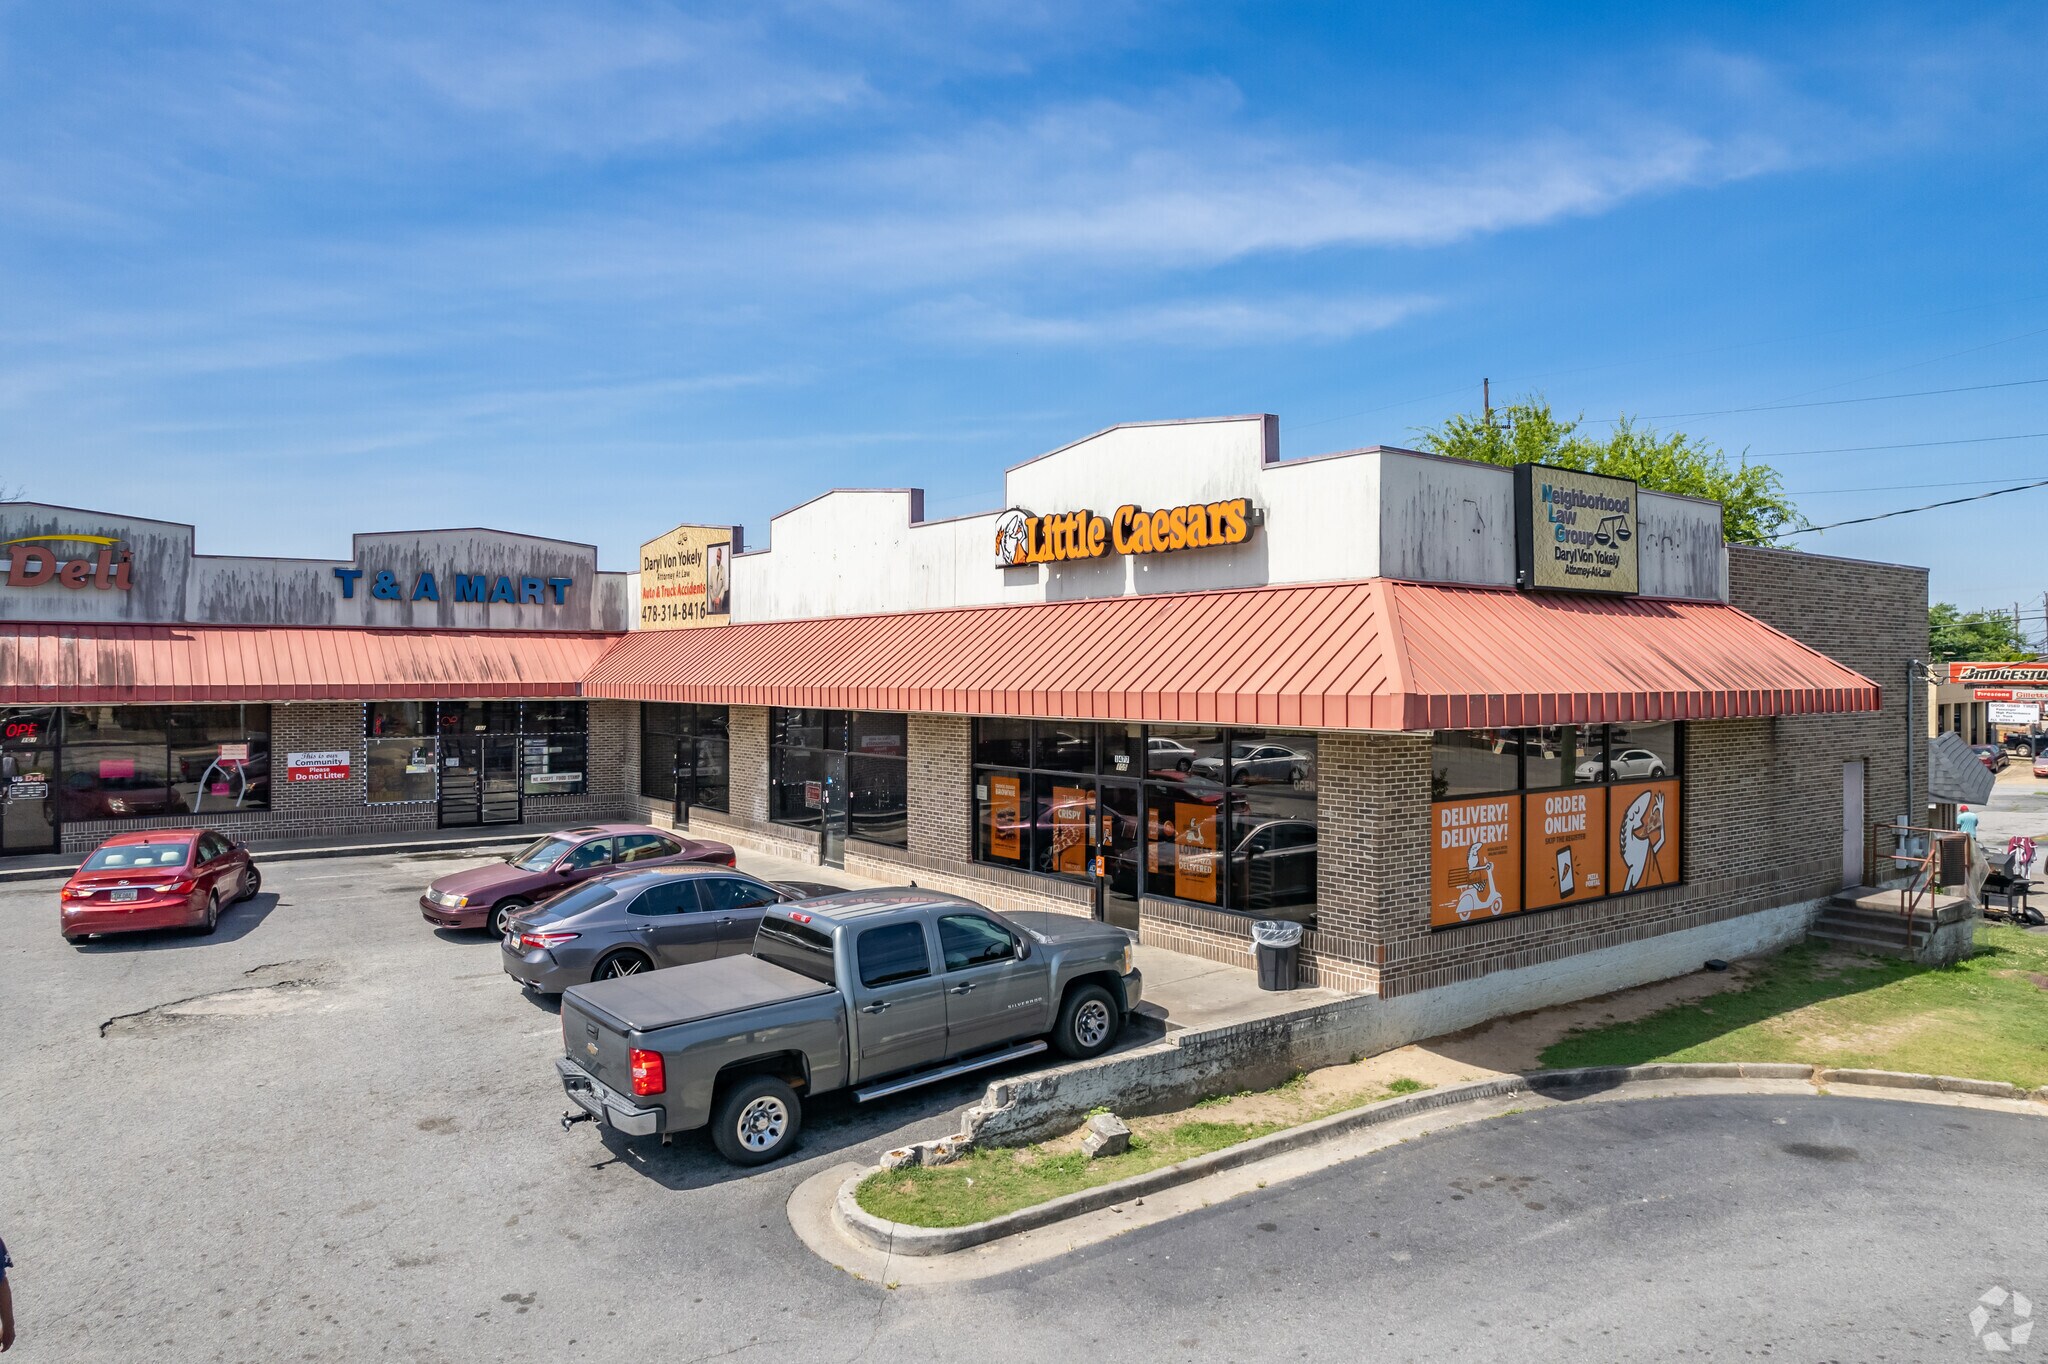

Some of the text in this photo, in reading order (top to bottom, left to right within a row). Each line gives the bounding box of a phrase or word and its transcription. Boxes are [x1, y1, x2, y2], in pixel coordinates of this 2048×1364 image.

[1541, 483, 1630, 514] Neighborhood
[1548, 503, 1577, 525] Law
[1024, 498, 1250, 564] Little Caesars
[1554, 523, 1595, 549] Group
[5, 544, 135, 591] Deli
[644, 548, 702, 573] Daryl Von Yokely
[1554, 546, 1620, 569] Daryl Von Yokely
[334, 568, 573, 605] T & A MART
[657, 572, 675, 580] Attorney
[642, 582, 706, 599] Auto & Truck Accidents
[641, 602, 706, 622] 478-314-8416
[1959, 667, 2048, 681] BRIDGESTO
[301, 752, 316, 760] This
[25, 773, 45, 782] Deli
[1293, 780, 1316, 792] OPEN
[1057, 808, 1081, 820] CRISPY
[1441, 803, 1509, 828] DELIVERY!
[1545, 794, 1586, 815] ORDER
[1545, 813, 1586, 835] ONLINE
[1441, 823, 1509, 849] DELIVERY!
[1179, 861, 1213, 874] DELIVERED
